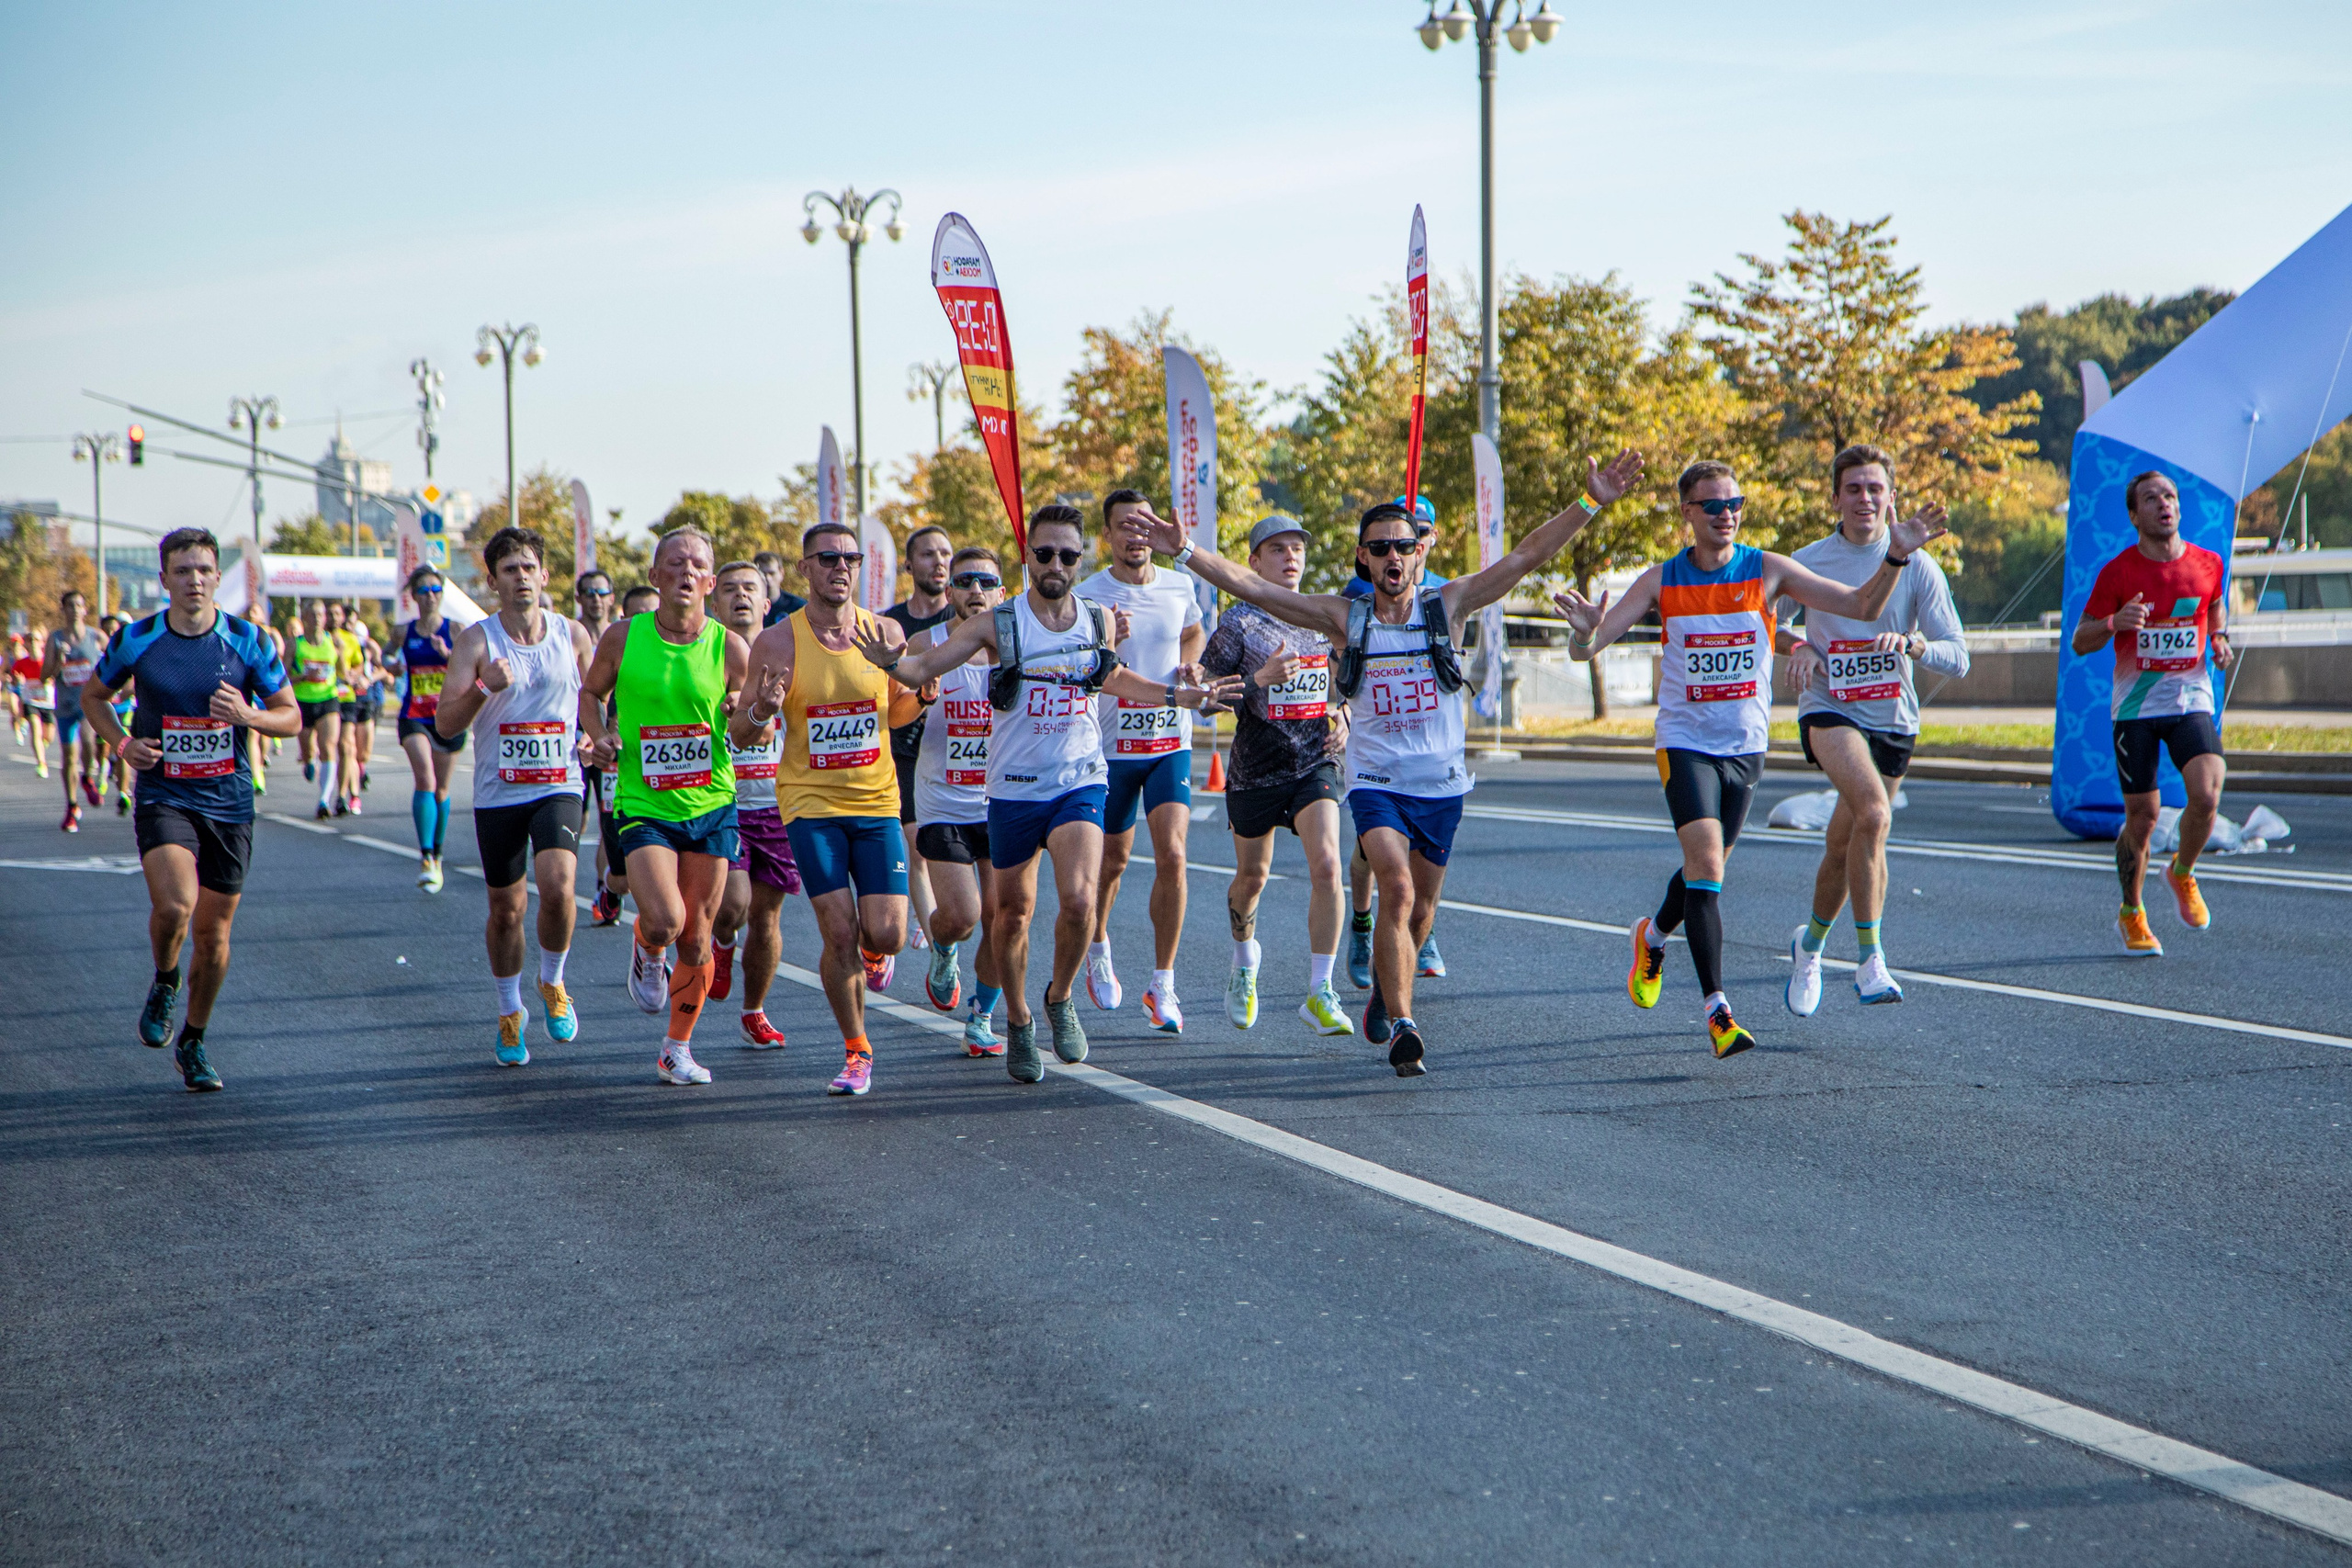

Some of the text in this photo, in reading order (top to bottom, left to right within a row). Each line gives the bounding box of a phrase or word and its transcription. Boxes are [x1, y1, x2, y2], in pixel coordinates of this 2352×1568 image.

[2140, 631, 2195, 649] 31962
[1688, 649, 1754, 673] 33075
[1831, 653, 1895, 678] 36555
[1025, 665, 1075, 675] МАРАФОН
[1365, 668, 1407, 679] МОСКВА
[1702, 673, 1742, 682] АЛЕКСАНДР
[1846, 675, 1883, 685] ВЛАДИСЛАВ
[1372, 678, 1439, 716] 0:39
[1121, 710, 1177, 730] 23952
[1385, 720, 1408, 733] 3:54
[811, 717, 876, 742] 24449
[1034, 722, 1057, 735] 3:54
[166, 731, 231, 753] 28393
[502, 739, 561, 759] 39011
[829, 741, 863, 750] ВЯЧЕСЛАВ
[644, 740, 708, 764] 26366
[1005, 774, 1037, 783] СИБУР
[1357, 773, 1391, 784] СИБУР
